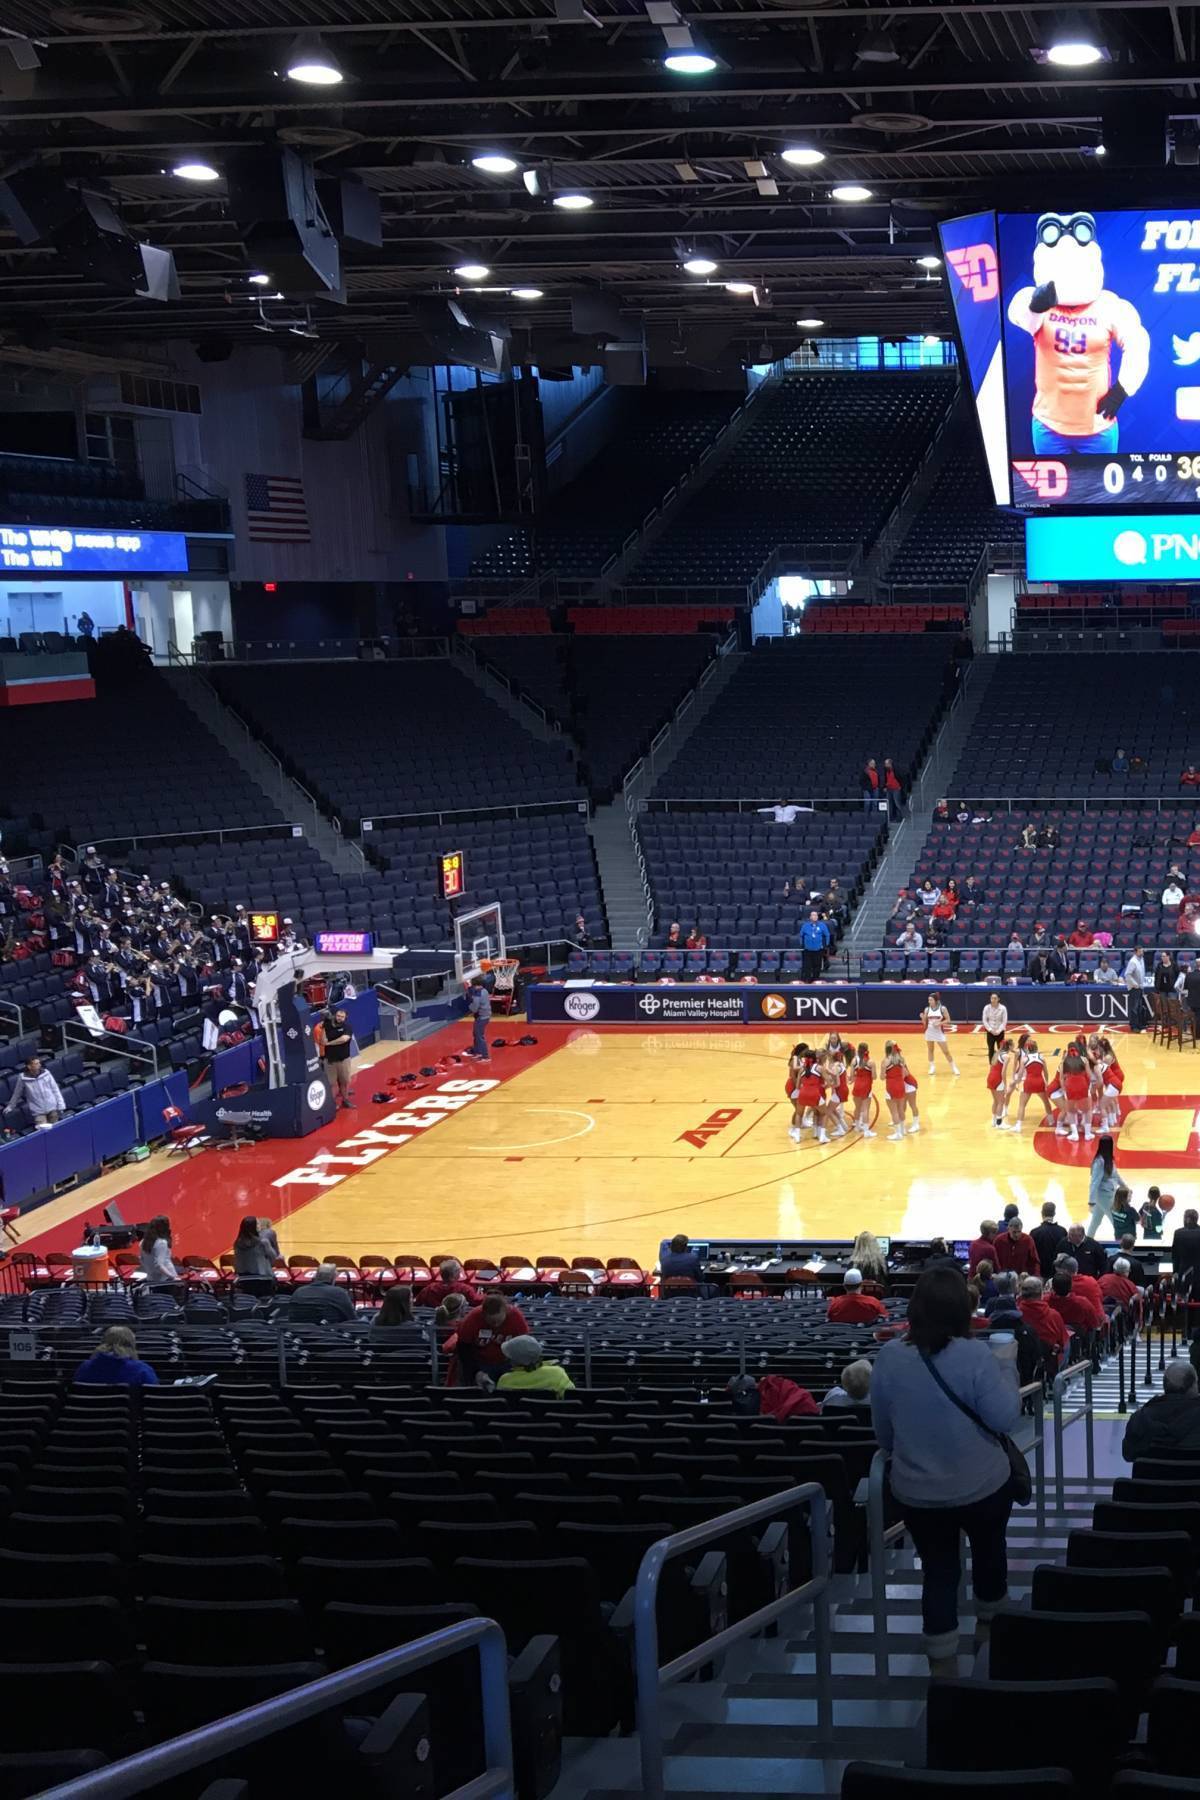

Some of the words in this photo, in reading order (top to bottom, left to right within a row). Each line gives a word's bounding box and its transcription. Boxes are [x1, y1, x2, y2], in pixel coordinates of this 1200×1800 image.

[1103, 462, 1124, 494] 0
[1132, 465, 1144, 482] 4
[1155, 465, 1167, 482] 0
[319, 933, 364, 943] DAYTON
[321, 943, 363, 952] FLYERS
[568, 993, 596, 1016] Kroger
[663, 998, 706, 1009] Premier
[709, 998, 743, 1009] Health
[793, 997, 848, 1018] PNC
[687, 1010, 708, 1018] Valley
[709, 1010, 739, 1018] Hospital
[270, 1079, 501, 1187] FLYERS
